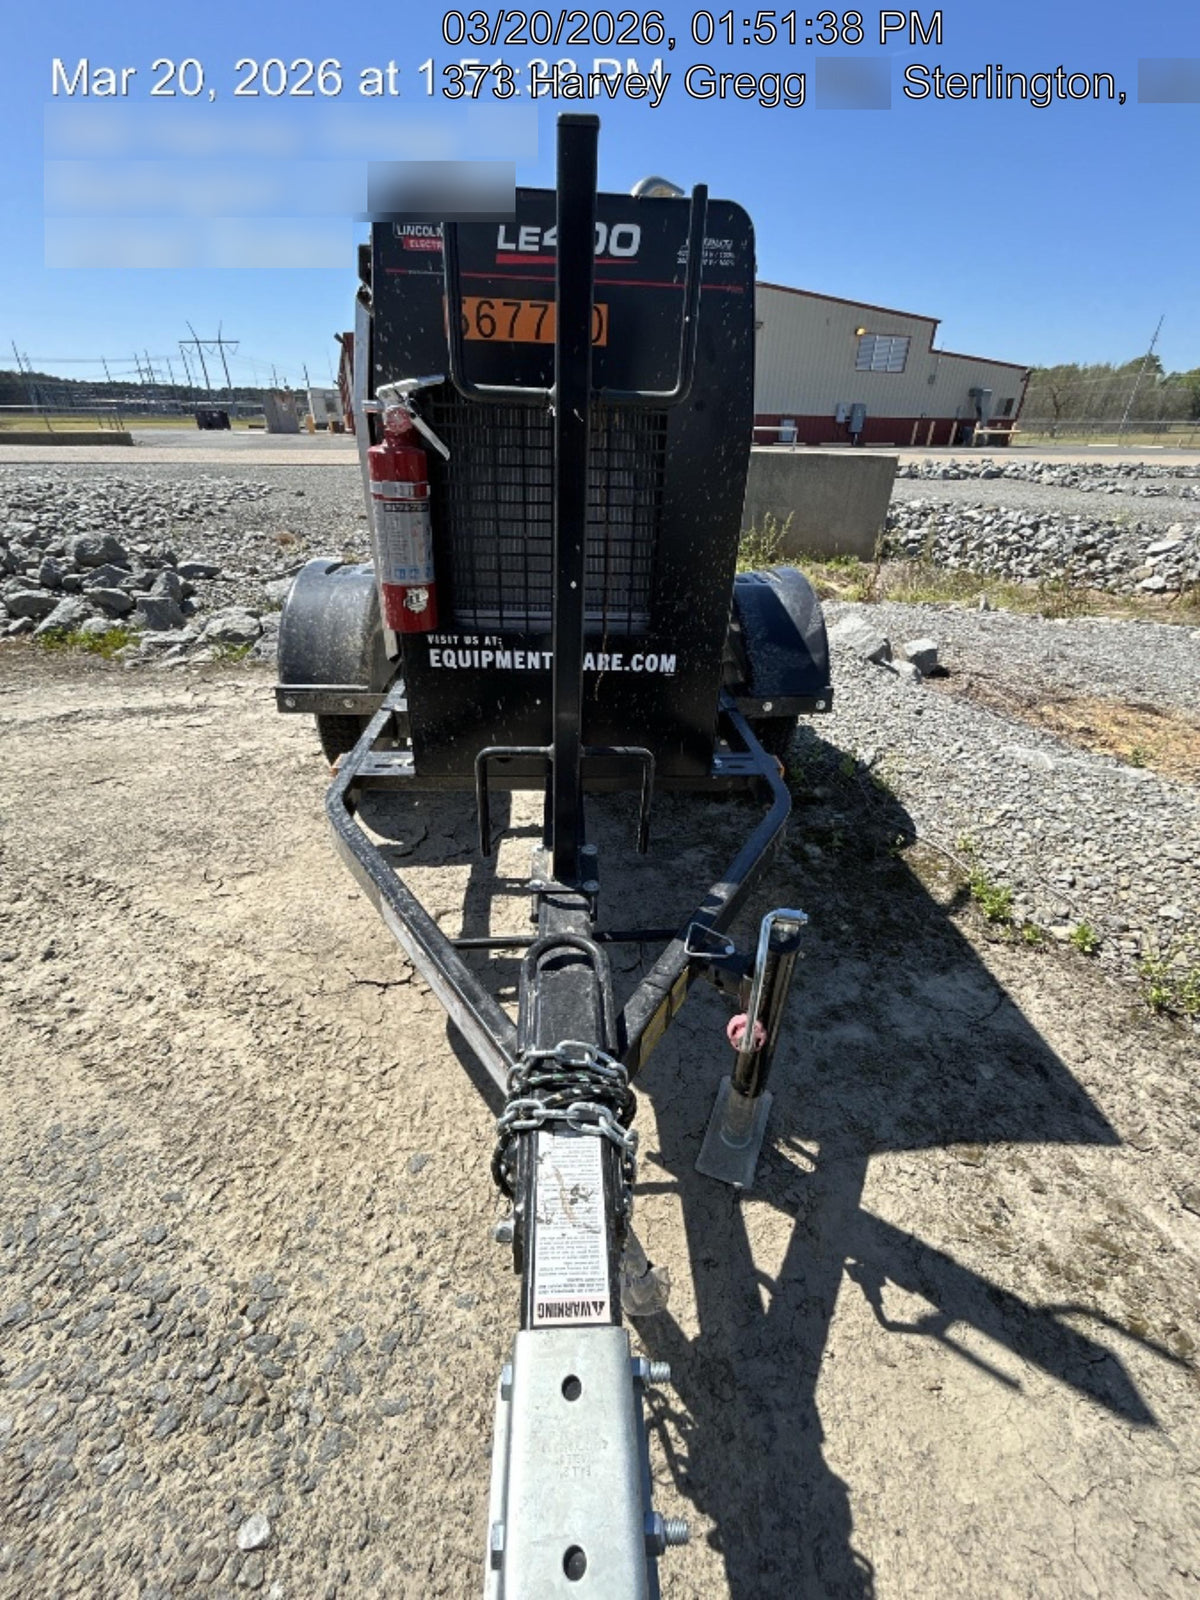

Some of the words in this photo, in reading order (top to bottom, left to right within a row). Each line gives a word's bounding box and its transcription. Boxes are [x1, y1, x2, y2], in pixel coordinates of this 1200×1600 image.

[427, 634, 459, 645] VISIT
[463, 636, 479, 645] US
[429, 648, 676, 673] EQUIPMENTARE.COM
[538, 1301, 592, 1318] WARNING
